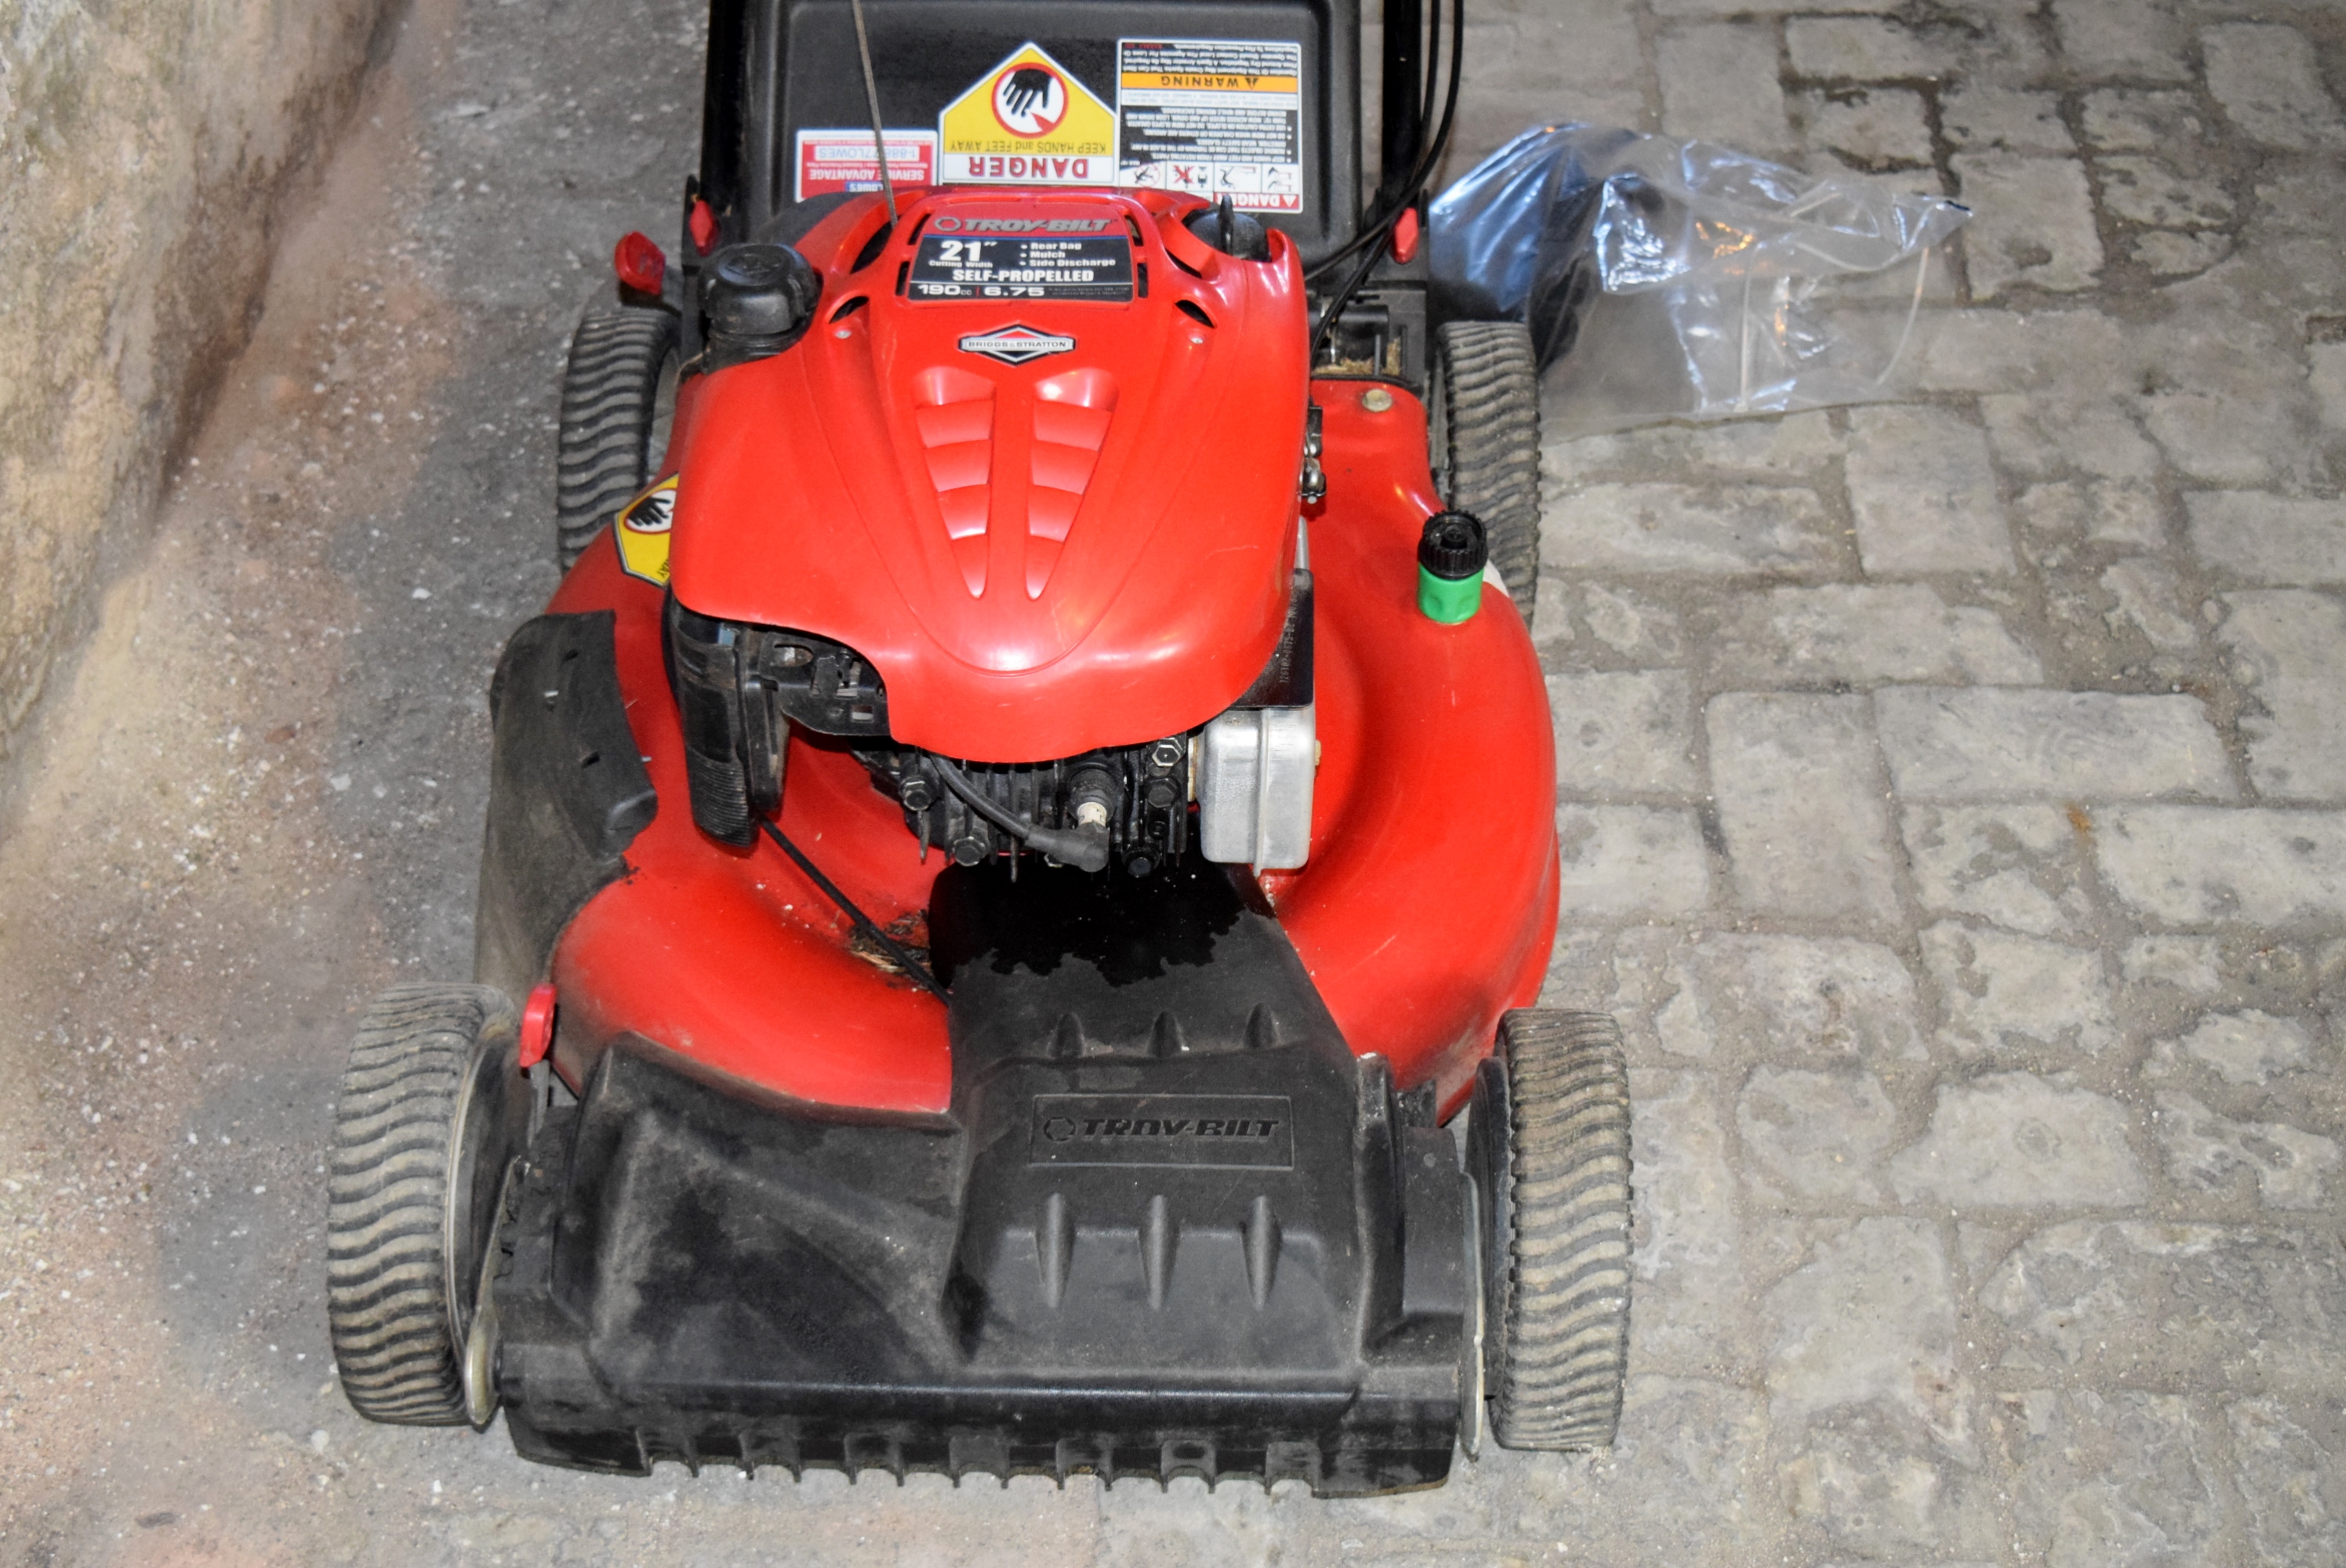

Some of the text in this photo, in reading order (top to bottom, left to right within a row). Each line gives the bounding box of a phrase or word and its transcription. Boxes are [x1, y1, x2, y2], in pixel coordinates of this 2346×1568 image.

[1160, 76, 1238, 88] WARNING
[950, 140, 1106, 154] KEEP HANDS and FEET AWAY
[809, 169, 876, 181] ADVANTAGE
[969, 158, 1088, 179] DANGER
[964, 218, 1111, 232] TROY-BILT
[1057, 259, 1117, 267] Discharge
[952, 269, 1095, 282] SELF-PROPELLED
[983, 286, 1045, 297] 6.75
[1083, 1119, 1280, 1138] TROY-BILT
